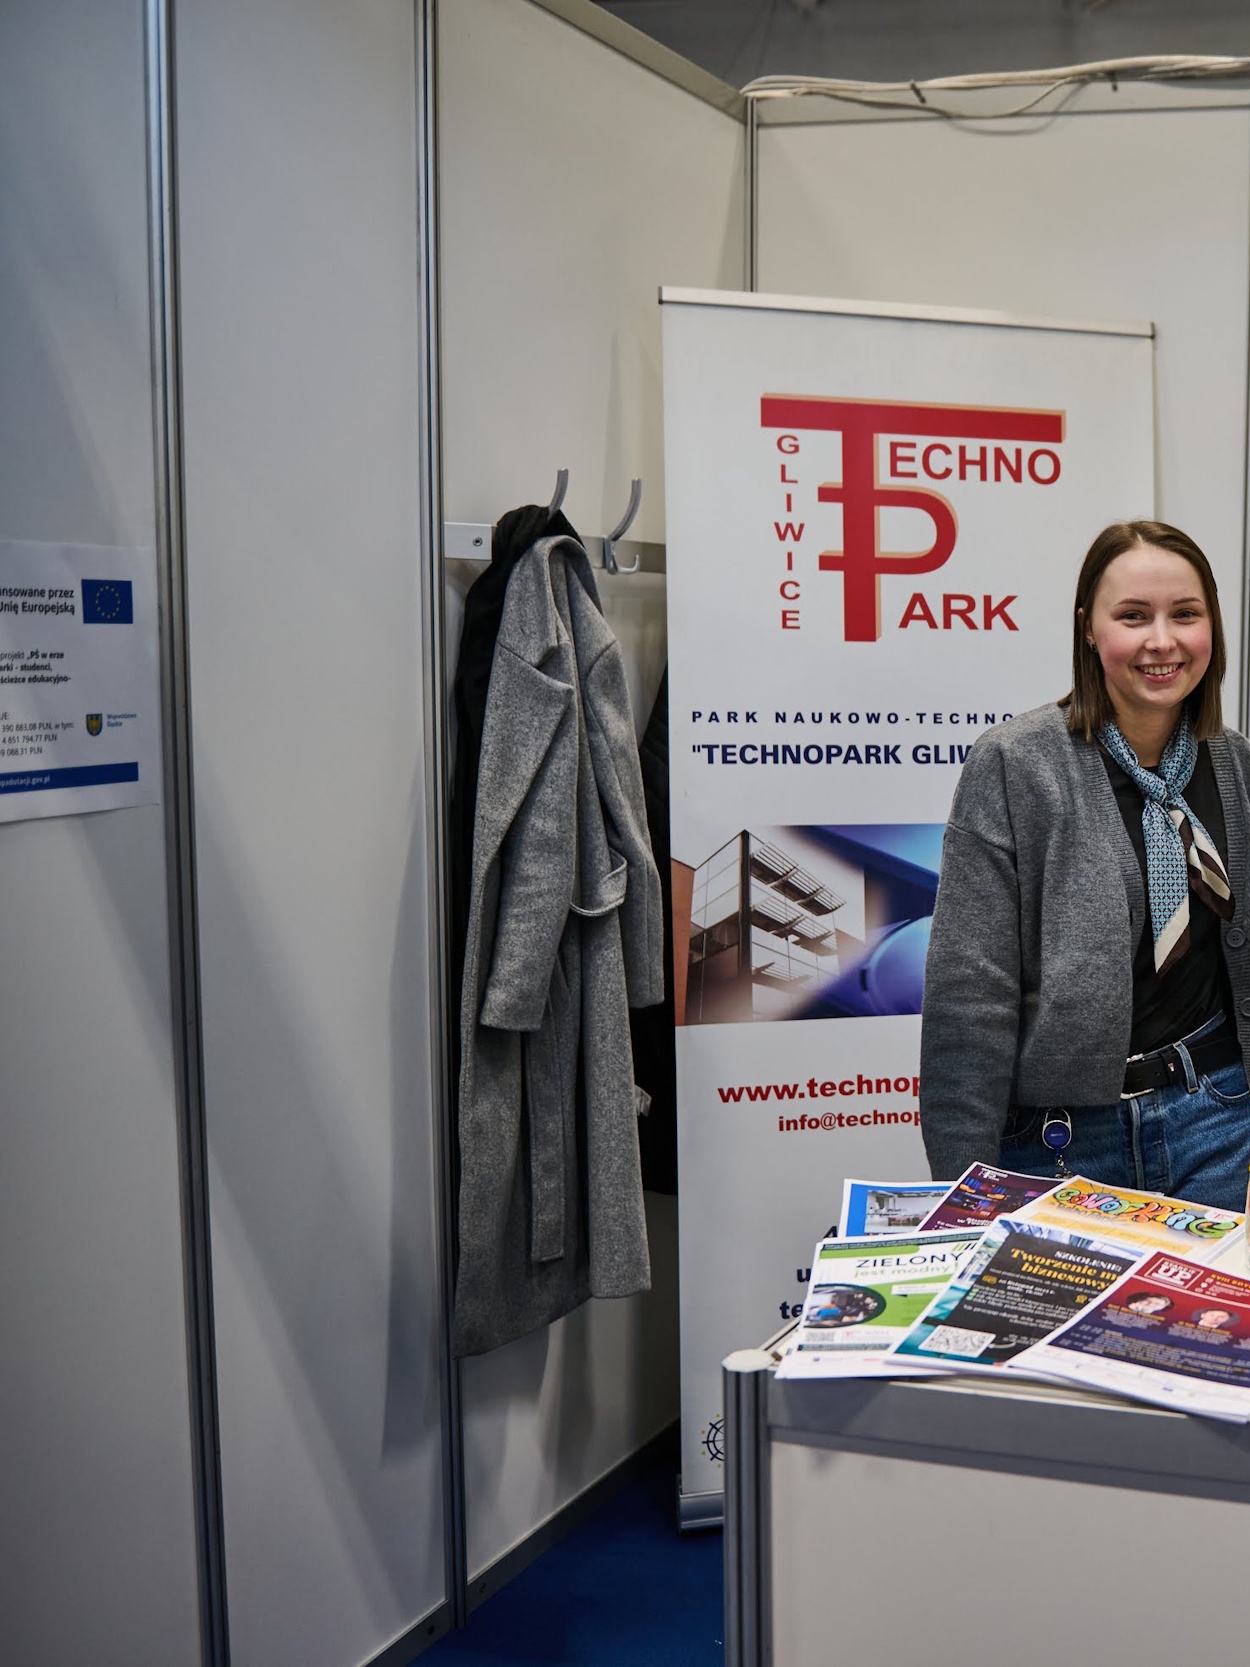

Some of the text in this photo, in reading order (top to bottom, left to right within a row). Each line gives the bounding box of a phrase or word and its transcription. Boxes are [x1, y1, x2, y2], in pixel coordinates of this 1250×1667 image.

[48, 589, 75, 600] przez
[22, 602, 75, 615] Europejską
[692, 711, 758, 723] PARK
[692, 744, 902, 765] "TECHNOPARK
[856, 1252, 964, 1268] ZIELONY
[1011, 1248, 1097, 1276] Tworzenie
[854, 1267, 885, 1278] jest
